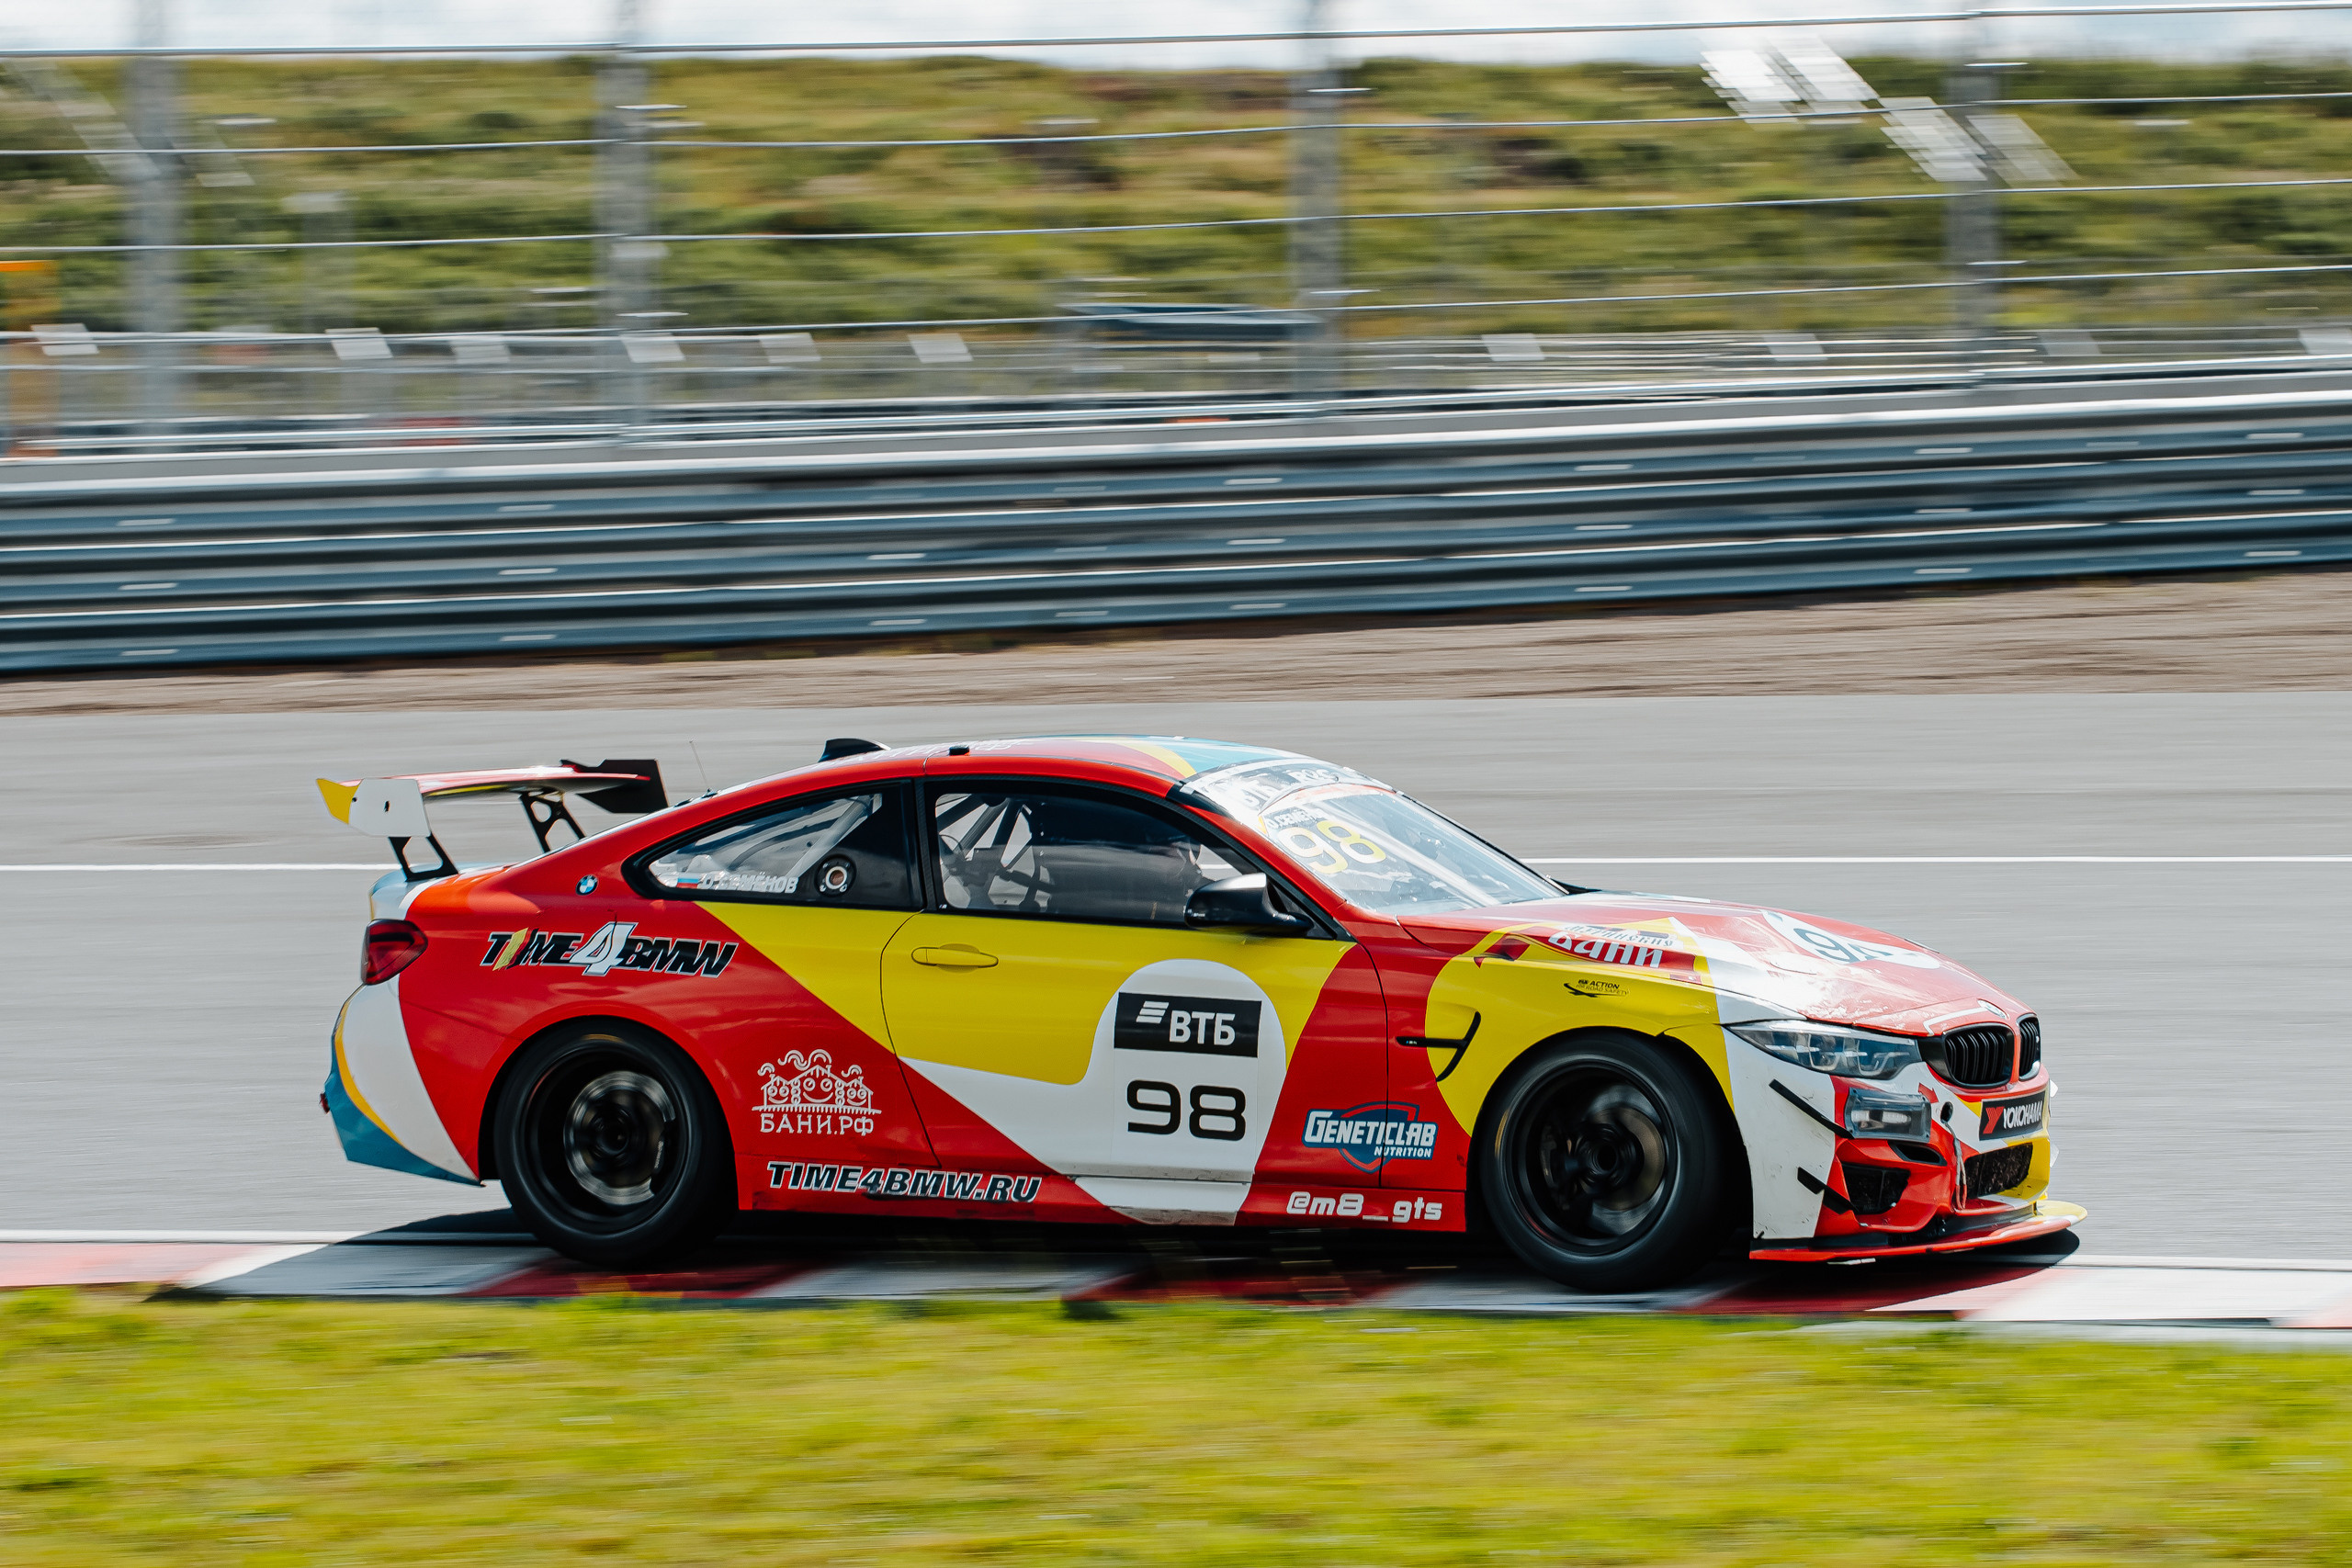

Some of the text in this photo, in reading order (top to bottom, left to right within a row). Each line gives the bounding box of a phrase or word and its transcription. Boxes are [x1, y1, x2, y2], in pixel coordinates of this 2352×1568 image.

[1277, 819, 1386, 874] 98
[480, 921, 739, 978] TIME4BMW
[1589, 980, 1620, 989] ACTION
[1169, 1010, 1236, 1046] ВТБ
[760, 1112, 875, 1136] БАНИ.РФ
[1126, 1078, 1247, 1142] 98
[2003, 1100, 2043, 1130] YOKOHAMA
[1374, 1145, 1432, 1158] NUTRITION
[766, 1161, 1042, 1203] TIME4BMW.RU
